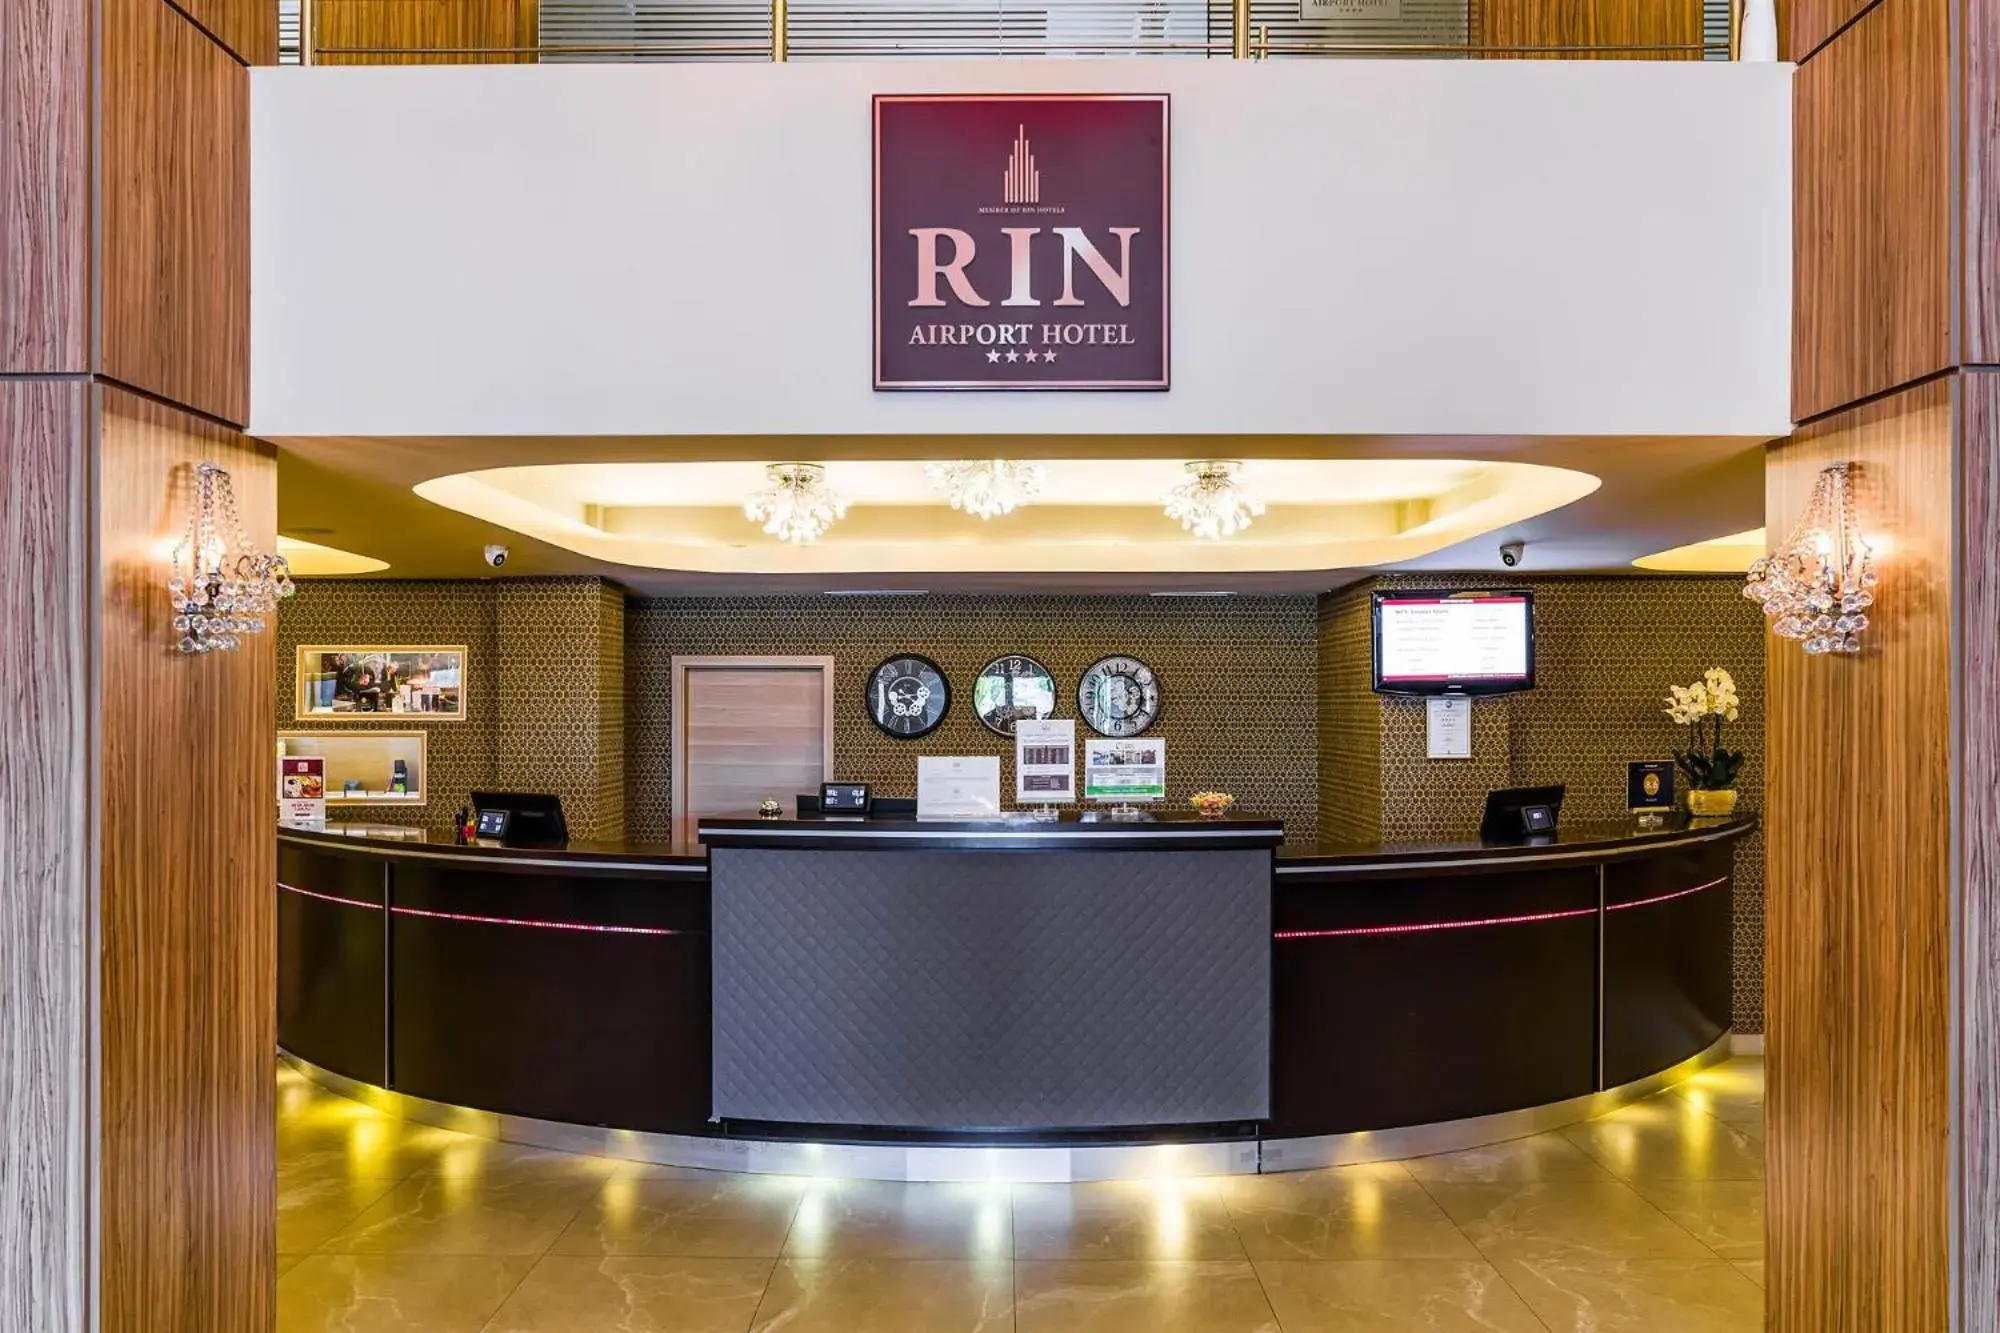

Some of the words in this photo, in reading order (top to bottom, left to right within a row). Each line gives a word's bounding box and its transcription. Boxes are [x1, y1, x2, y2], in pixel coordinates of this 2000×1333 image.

[908, 227, 1140, 307] RIN
[908, 324, 1033, 345] AIRPORT
[1041, 324, 1135, 345] HOTEL
[1009, 659, 1021, 670] 12
[1116, 663, 1128, 674] 12
